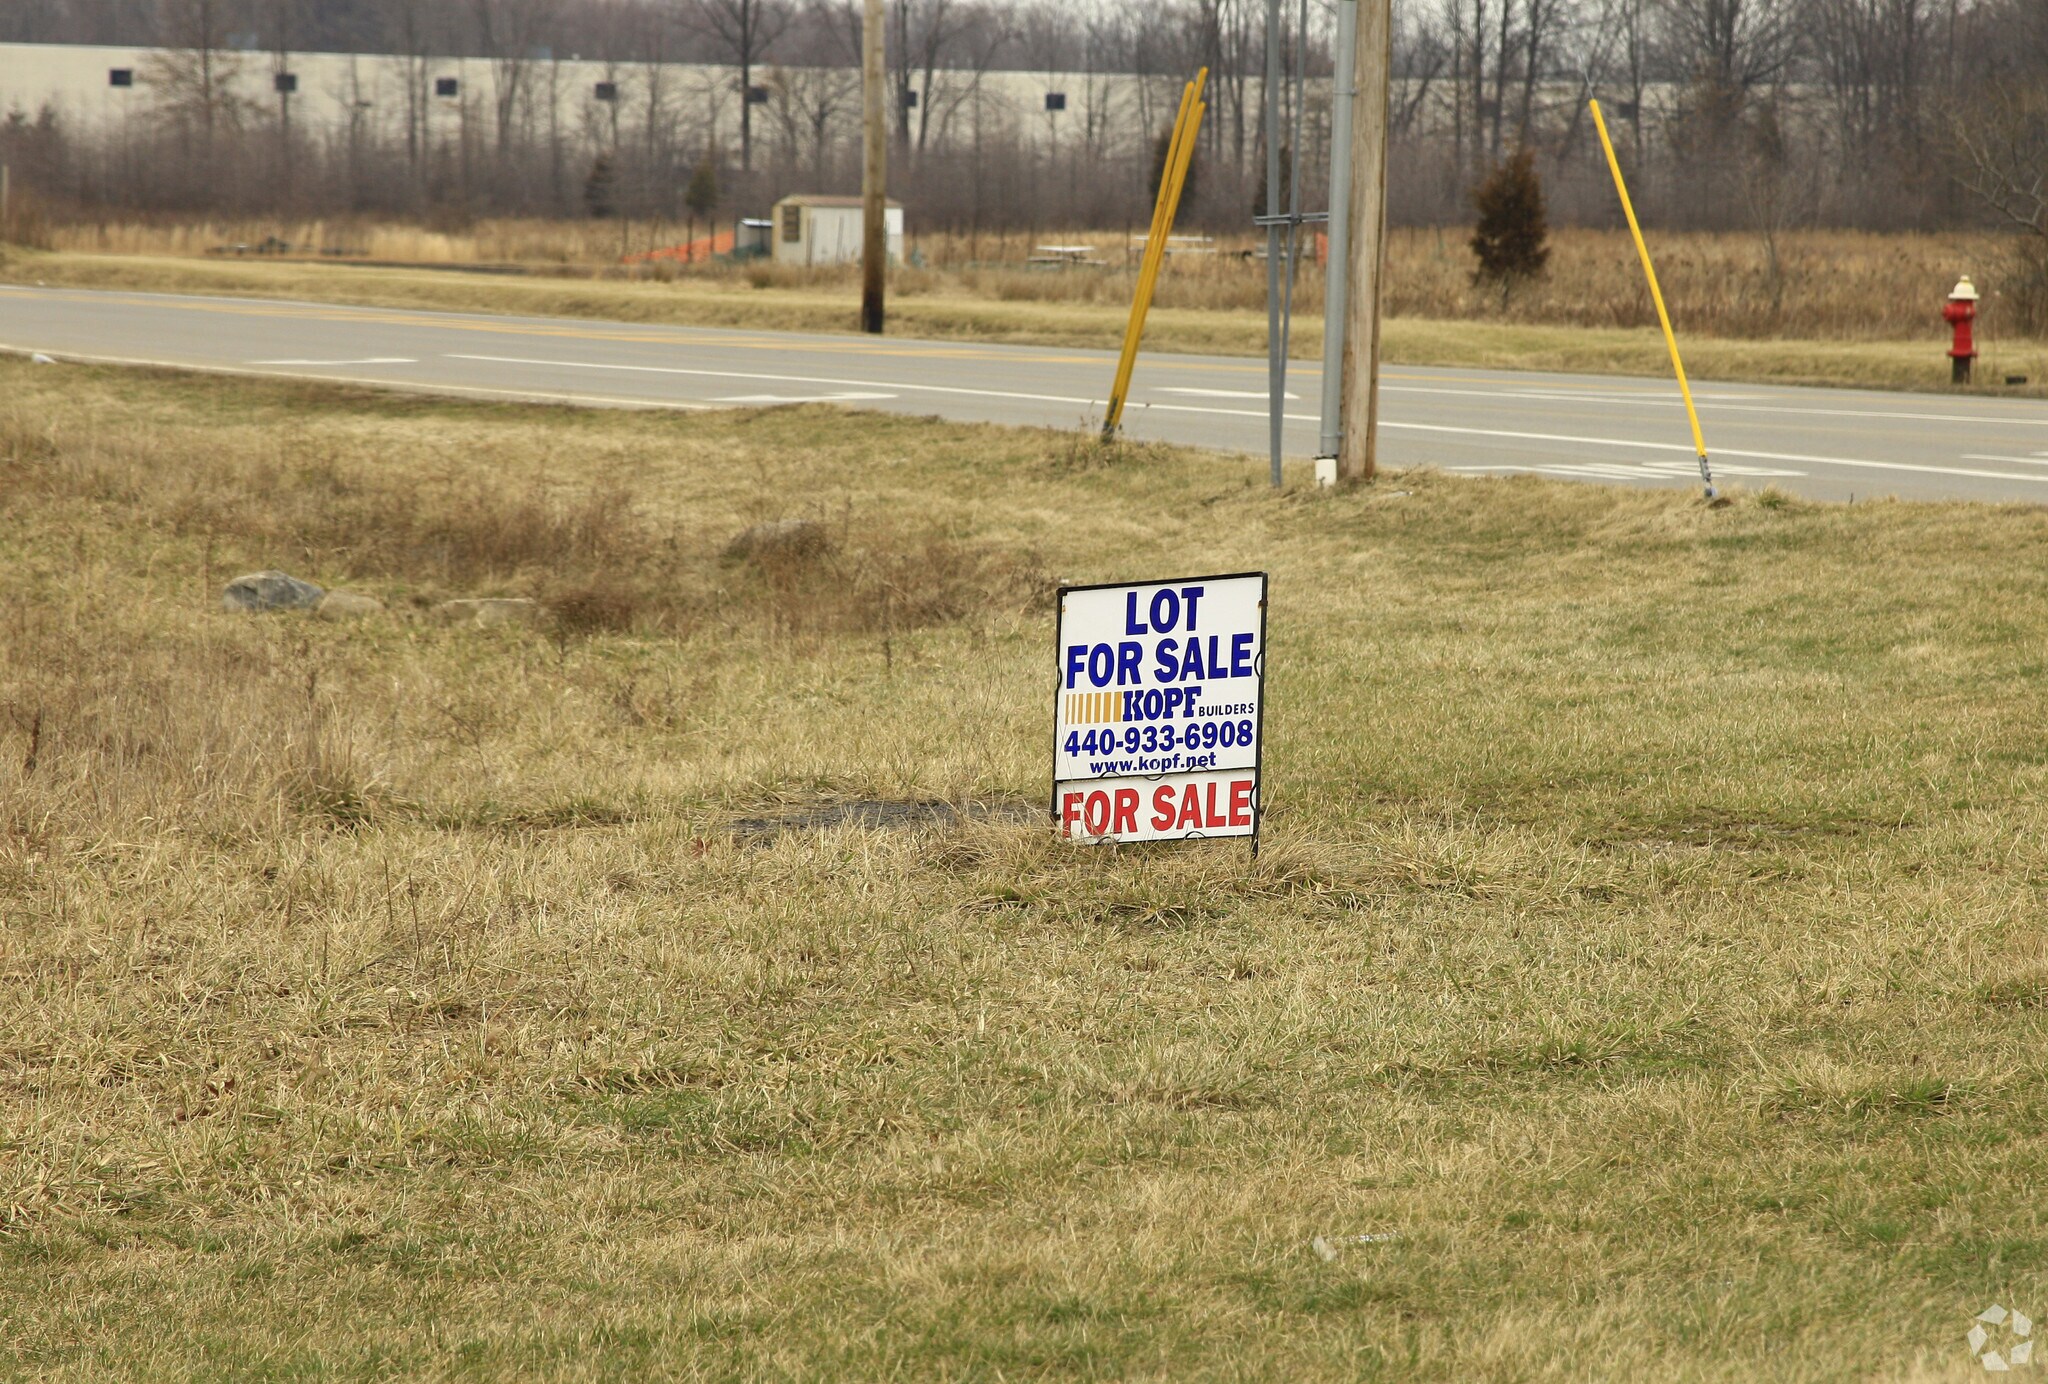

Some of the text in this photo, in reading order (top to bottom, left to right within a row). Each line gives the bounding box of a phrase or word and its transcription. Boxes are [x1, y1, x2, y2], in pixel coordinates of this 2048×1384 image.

[1125, 586, 1204, 636] LOT
[1066, 632, 1254, 689] FOR SALE
[1122, 686, 1255, 722] KOPF BUILDERS
[1063, 719, 1253, 757] 440-933-6908
[1090, 751, 1217, 773] www.kopf.net
[1062, 780, 1253, 838] FOR SALE
